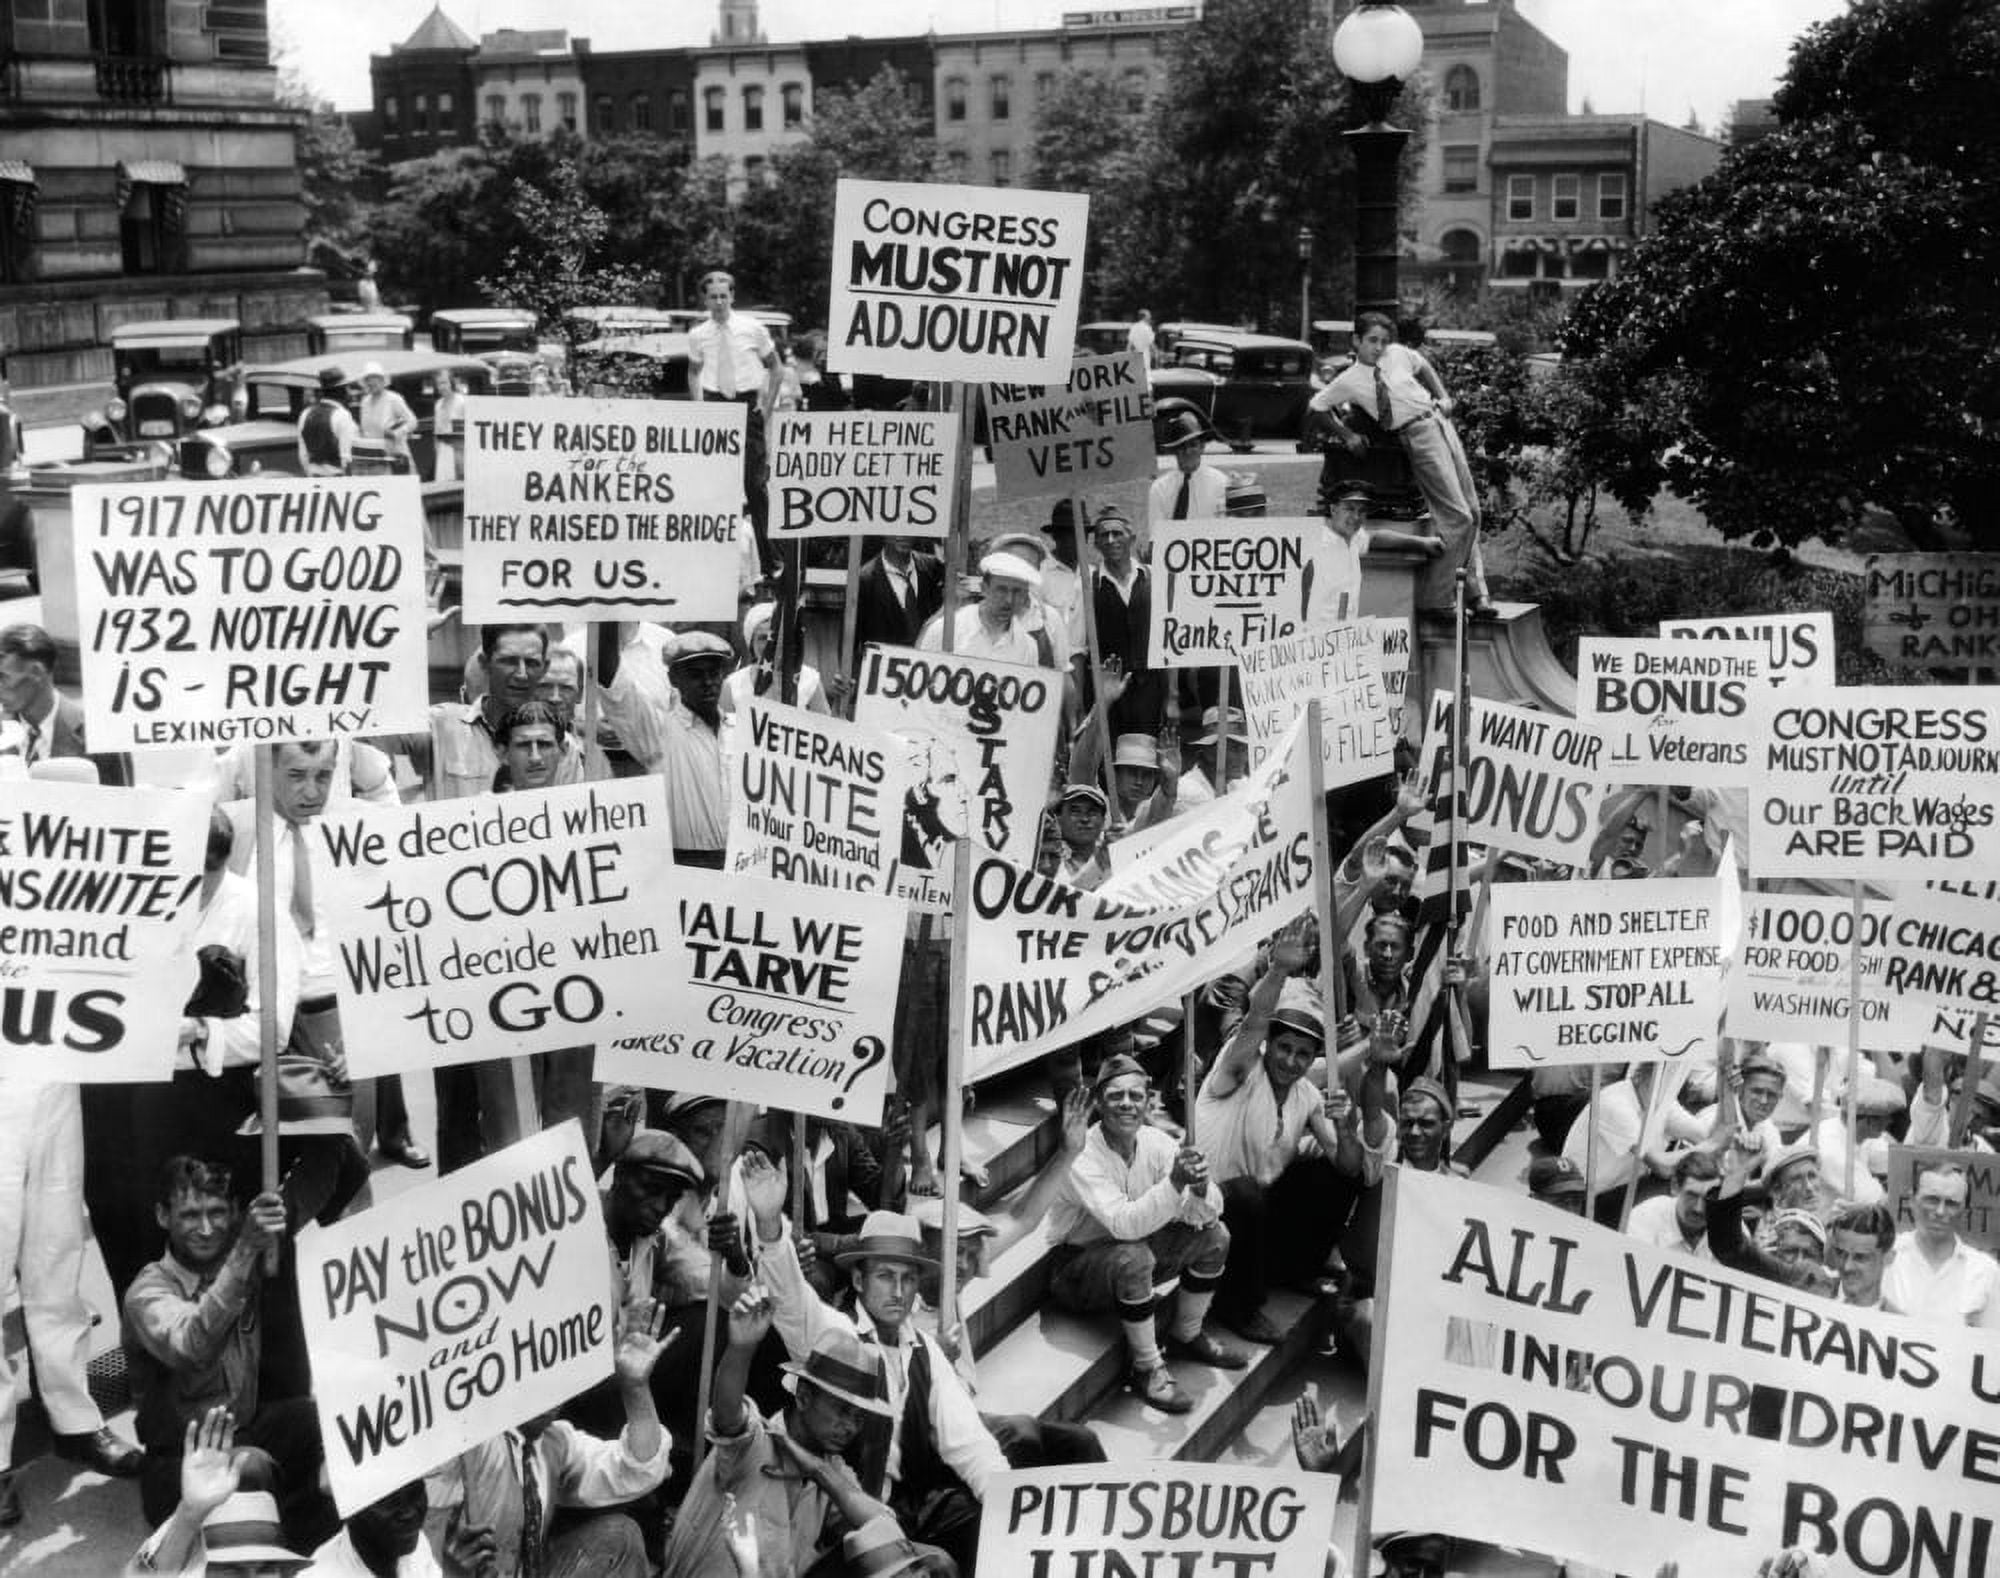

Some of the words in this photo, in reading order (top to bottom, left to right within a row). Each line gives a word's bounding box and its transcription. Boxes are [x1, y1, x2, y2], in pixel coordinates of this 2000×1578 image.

[863, 199, 1059, 248] CONGRESS
[850, 240, 990, 294] MUST
[992, 252, 1071, 300] NOT
[846, 300, 1050, 358] ADJOURN
[474, 421, 543, 451] THEY
[554, 423, 636, 452] RAISED
[645, 426, 740, 456] BILLIONS
[992, 407, 1070, 443] RANK
[776, 452, 846, 480] DADDY
[902, 452, 944, 477] THE
[1028, 436, 1114, 477] VETS
[524, 471, 675, 503] BANKERS
[780, 484, 937, 530] BONUS
[99, 495, 185, 538] 1917
[467, 515, 521, 542] THEY
[530, 514, 619, 542] RAISED
[626, 514, 659, 541] THE
[665, 514, 737, 543] BRIDGE
[92, 549, 197, 597] WAS
[209, 547, 272, 594] TO
[284, 544, 401, 593] GOOD
[502, 558, 572, 588] FOR
[594, 559, 660, 589] US.
[1164, 536, 1302, 573] OREGON
[1190, 573, 1286, 598] UNIT
[93, 608, 196, 653] 1932
[1163, 615, 1221, 656] Rank
[1901, 634, 2000, 659] RANK
[226, 660, 390, 709] RIGHT
[1595, 677, 1747, 718] BONUS
[750, 707, 885, 784] VETERANS
[1480, 710, 1550, 757] WANT
[1552, 729, 1603, 771] OUR
[1772, 708, 1988, 743] CONGRESS
[1648, 734, 1748, 765] Veterans
[1767, 743, 1835, 773] MUST
[1837, 743, 1900, 773] NOT
[1898, 745, 2000, 774] ADJOURN
[742, 752, 881, 838] UNITE
[1763, 798, 1823, 826] Our
[1833, 798, 1911, 827] Back
[1912, 793, 1995, 834] Wages
[22, 811, 173, 868] WHITE
[320, 818, 389, 868] We
[398, 800, 552, 858] decided
[562, 788, 647, 836] when
[762, 808, 795, 843] Your
[803, 821, 880, 871] Demand
[1785, 829, 1865, 857] ARE
[1878, 830, 1975, 860] PAID
[364, 880, 432, 933] to
[445, 841, 629, 922] COME
[791, 917, 864, 963] WE
[1503, 915, 1558, 939] FOOD
[1569, 913, 1612, 937] AND
[1619, 908, 1710, 934] SHELTER
[439, 930, 557, 981] decide
[571, 920, 661, 961] when
[1016, 929, 1090, 964] THE
[1496, 951, 1523, 977] AT
[1526, 947, 1645, 976] GOVERNMENT
[1650, 946, 1723, 970] EXPENSE
[1744, 946, 1782, 970] FOR
[1787, 949, 1840, 973] FOOD
[1513, 985, 1575, 1013] WILL
[1584, 983, 1646, 1011] STOP
[1647, 980, 1694, 1007] ALL
[1885, 956, 1968, 996] RANK
[405, 996, 474, 1045] to
[706, 993, 844, 1043] Congress
[971, 976, 1067, 1047] RANK
[1753, 990, 1890, 1023] WASHINGON
[611, 1033, 686, 1055] akes
[691, 1038, 716, 1060] a
[1557, 1020, 1660, 1047] BEGGING
[322, 1236, 389, 1320] PAY
[401, 1224, 457, 1286] the
[461, 1155, 588, 1263] BONUS
[374, 1240, 556, 1359] NOW
[1441, 1217, 1593, 1316] ALL
[1624, 1252, 1940, 1389] VETERANS
[428, 1317, 500, 1370] and
[444, 1352, 506, 1412] GO
[511, 1303, 605, 1382] Home
[1501, 1329, 1559, 1388] IN
[1592, 1355, 1743, 1435] OUR
[1787, 1391, 2000, 1484] DRIVE
[1414, 1388, 1577, 1485] FOR
[1612, 1436, 1751, 1538] THE
[1008, 1480, 1306, 1542] PITTSBURG
